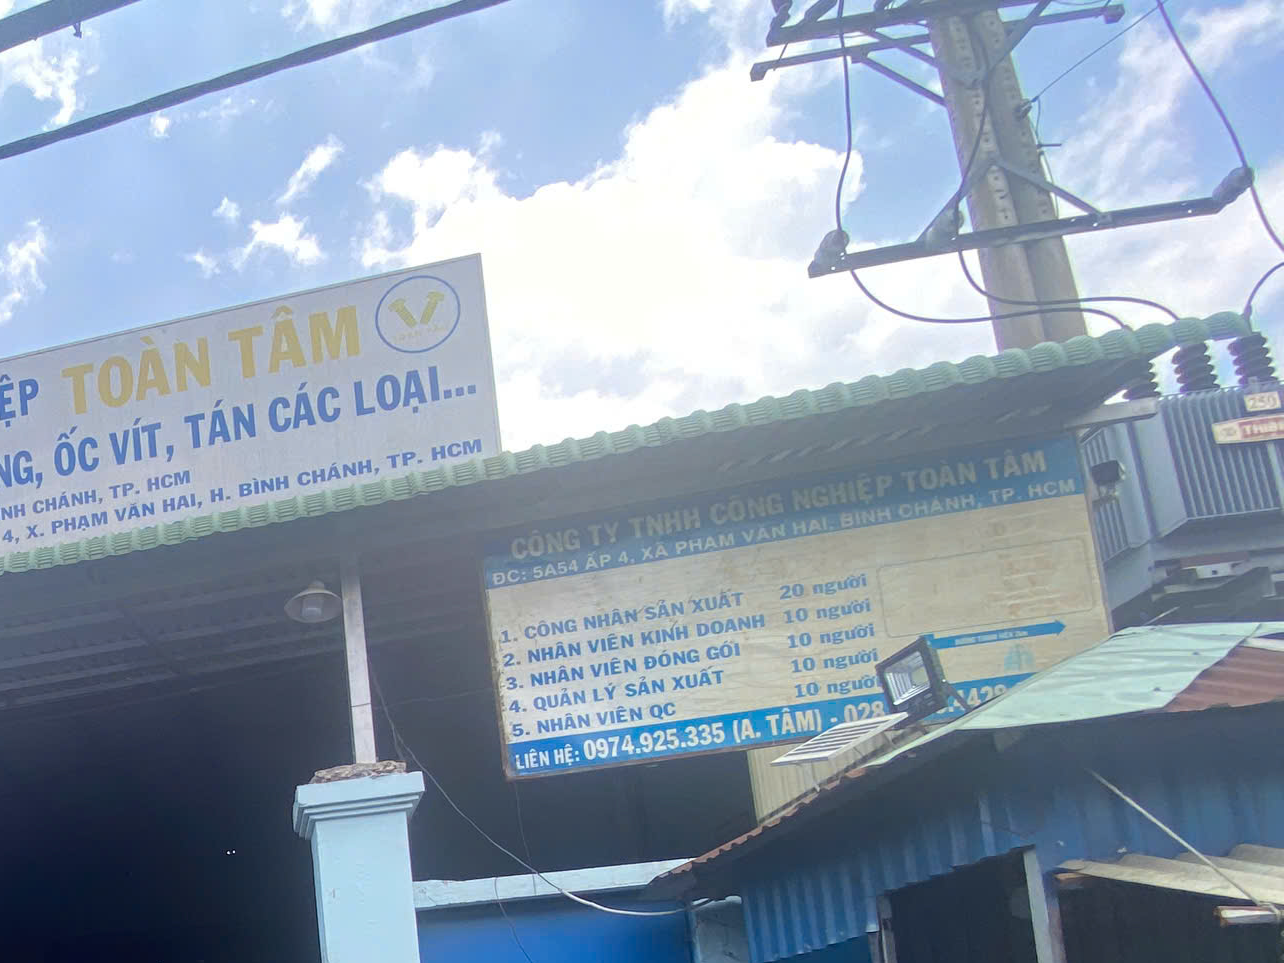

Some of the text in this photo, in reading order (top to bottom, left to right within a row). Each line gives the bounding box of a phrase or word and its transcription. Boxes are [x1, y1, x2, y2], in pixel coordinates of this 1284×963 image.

[61, 335, 212, 415] TOÀN
[227, 304, 361, 380] TÂM
[53, 426, 100, 477] ỐC
[109, 417, 175, 466] VÍT,
[184, 400, 257, 450] TÁN
[268, 382, 342, 433] CÁC
[353, 365, 478, 417] LOẠI...
[3, 529, 20, 545] 4,
[27, 523, 44, 539] X.
[51, 511, 109, 536] PHẠM
[115, 502, 156, 522] VĂN
[162, 493, 203, 513] HAI,
[210, 487, 232, 503] H.
[238, 475, 289, 499] BÌNH
[296, 458, 380, 487] CHÁNH,
[386, 451, 420, 470] TP.
[431, 438, 483, 460] HCM
[32, 488, 104, 516] CHÁNH,
[109, 482, 142, 502] TP.
[147, 470, 191, 492] HCM
[510, 448, 1048, 560] CÔNG TY TNHH CÔNG NGHIỆP TOÀN TÂM
[492, 569, 527, 586] ĐC:
[533, 561, 578, 579] 5A54
[641, 538, 668, 560] XÃ
[1027, 479, 1076, 496] HCM
[500, 573, 868, 643] 1. CÔNG NHÂN SẢN XUẤT 20 người
[502, 598, 871, 667] 2. NHÂN VIÊN KINH DOANH 10 người
[506, 677, 524, 690] 3.
[530, 665, 584, 687] NHÂN
[590, 657, 637, 678] VIÊN
[643, 649, 700, 670] ĐÓNG
[787, 632, 813, 649] 10
[819, 623, 875, 647] người
[508, 648, 878, 713] 4. QUẢN LÝ SẢN XUẤT 10 người
[511, 723, 530, 737] 5.
[536, 713, 591, 734] NHÂN
[596, 706, 643, 726] VIÊN
[649, 703, 676, 719] QC
[795, 682, 820, 698] 10
[516, 749, 550, 770] LIÊN
[554, 743, 580, 766] HỆ:
[583, 721, 726, 761] 0974.925.335
[766, 707, 822, 737] TÂM)
